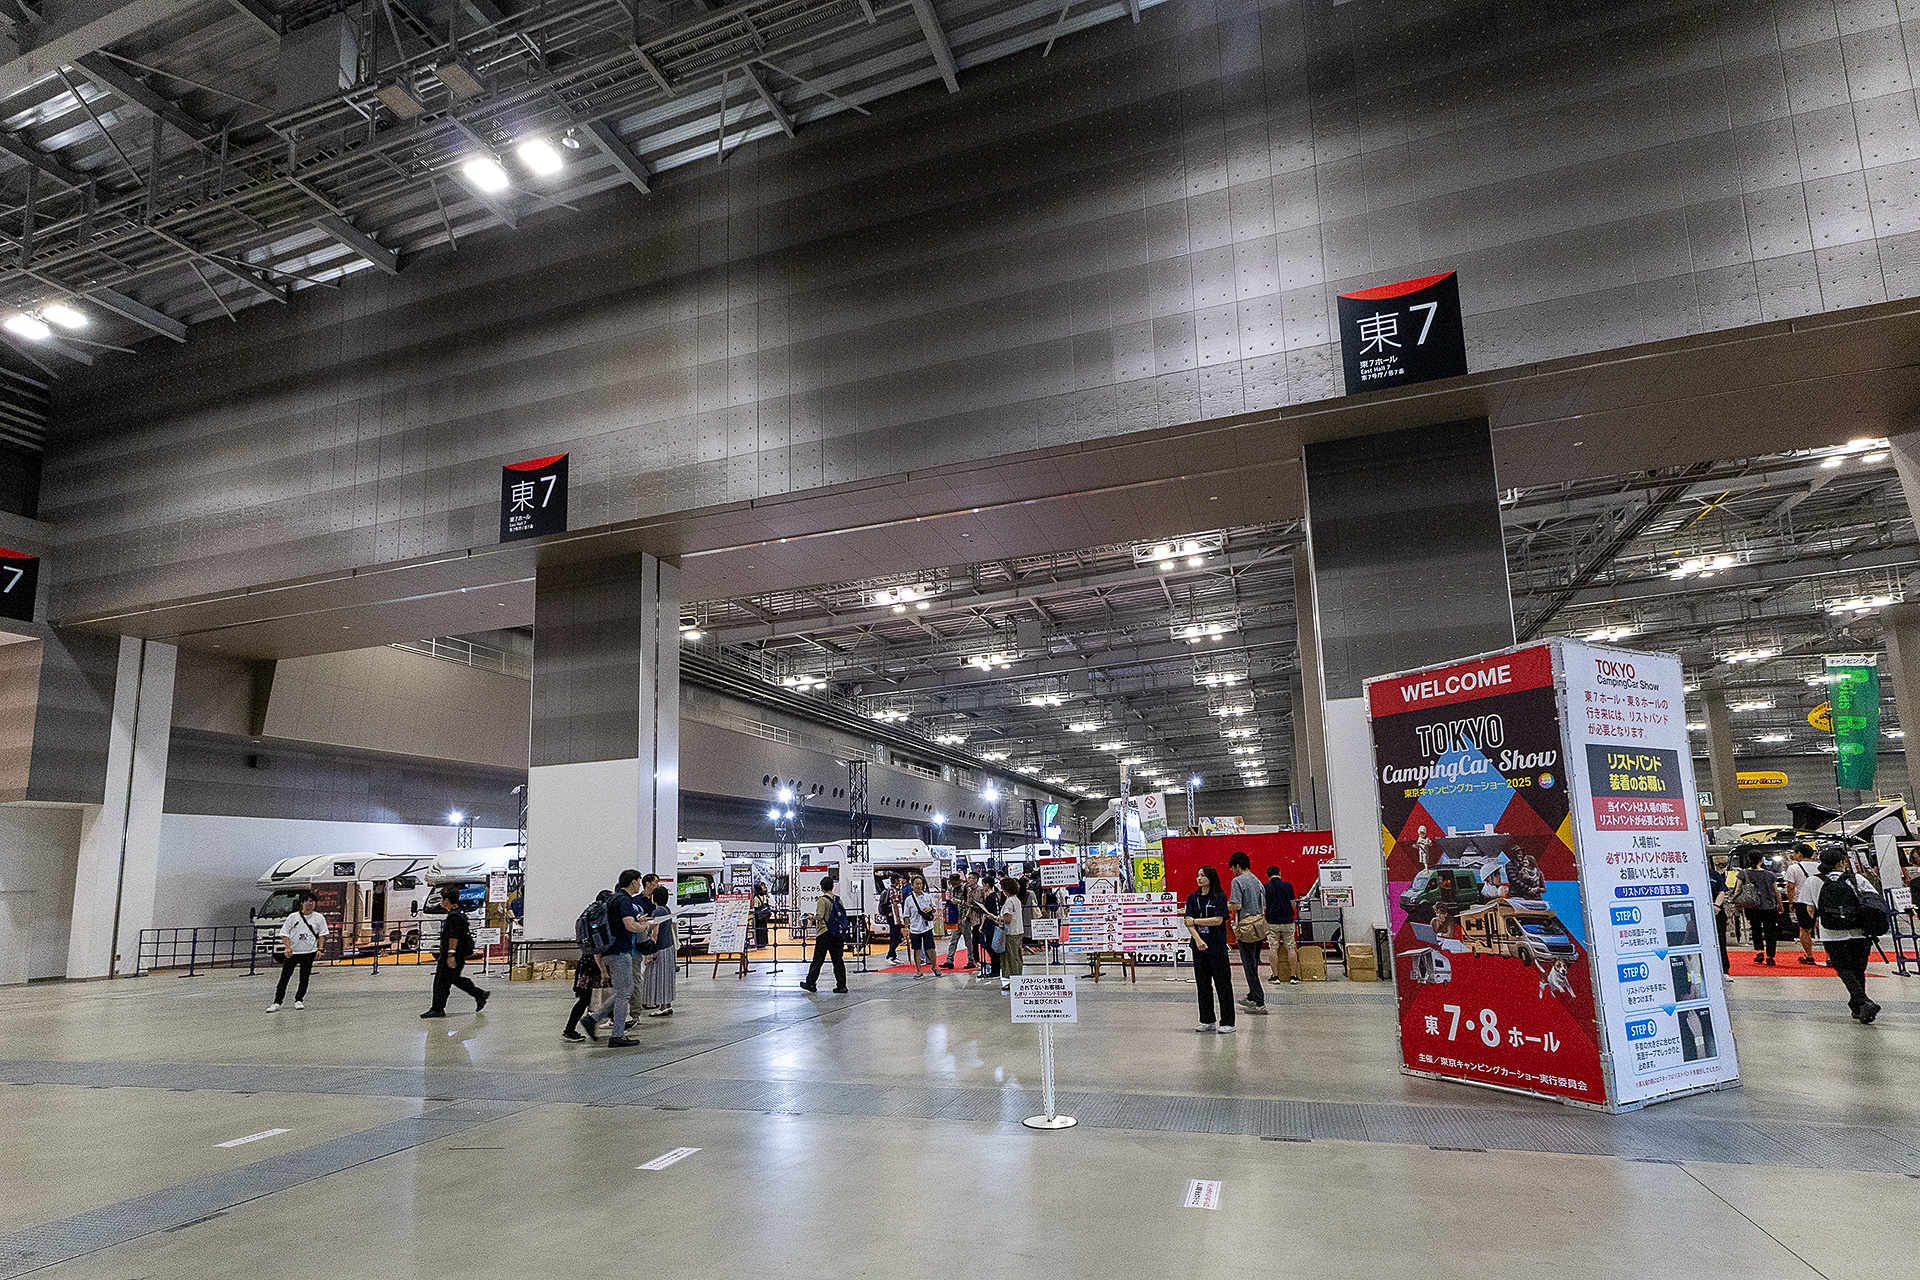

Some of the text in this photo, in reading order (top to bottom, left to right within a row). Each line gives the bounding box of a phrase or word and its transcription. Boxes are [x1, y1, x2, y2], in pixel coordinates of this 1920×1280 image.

[1356, 301, 1438, 355] 東7
[1360, 355, 1398, 368] 東7ホール
[510, 474, 557, 513] 東7
[1594, 659, 1635, 679] TOKYO
[1400, 664, 1512, 702] WELCOME
[1597, 674, 1660, 691] CampingCar Show
[1584, 690, 1668, 710] 東7ホール・東8ホールの
[1585, 706, 1669, 725] 行き来には、リストバンド
[1416, 713, 1504, 758] TOKYO
[1588, 723, 1648, 739] が必要となります。
[1382, 749, 1557, 786] CampingCar Show
[1607, 753, 1662, 772] リストバンド
[1404, 777, 1532, 798] 東京キャンピングカーショー2025
[1609, 773, 1666, 792] 装着のお願い
[1607, 801, 1674, 813] 当イベントは入場の際に
[1600, 814, 1684, 826] リストバンドが必要となります。
[1632, 836, 1661, 848] 入場前に
[1605, 851, 1688, 865] 必ずリストバンドの装着を
[1620, 867, 1680, 880] お願いいたします。
[1622, 885, 1682, 896] リストバンドの装着方法
[1615, 910, 1631, 921] STEP
[1623, 967, 1639, 979] STEP
[1631, 1025, 1647, 1036] STEP
